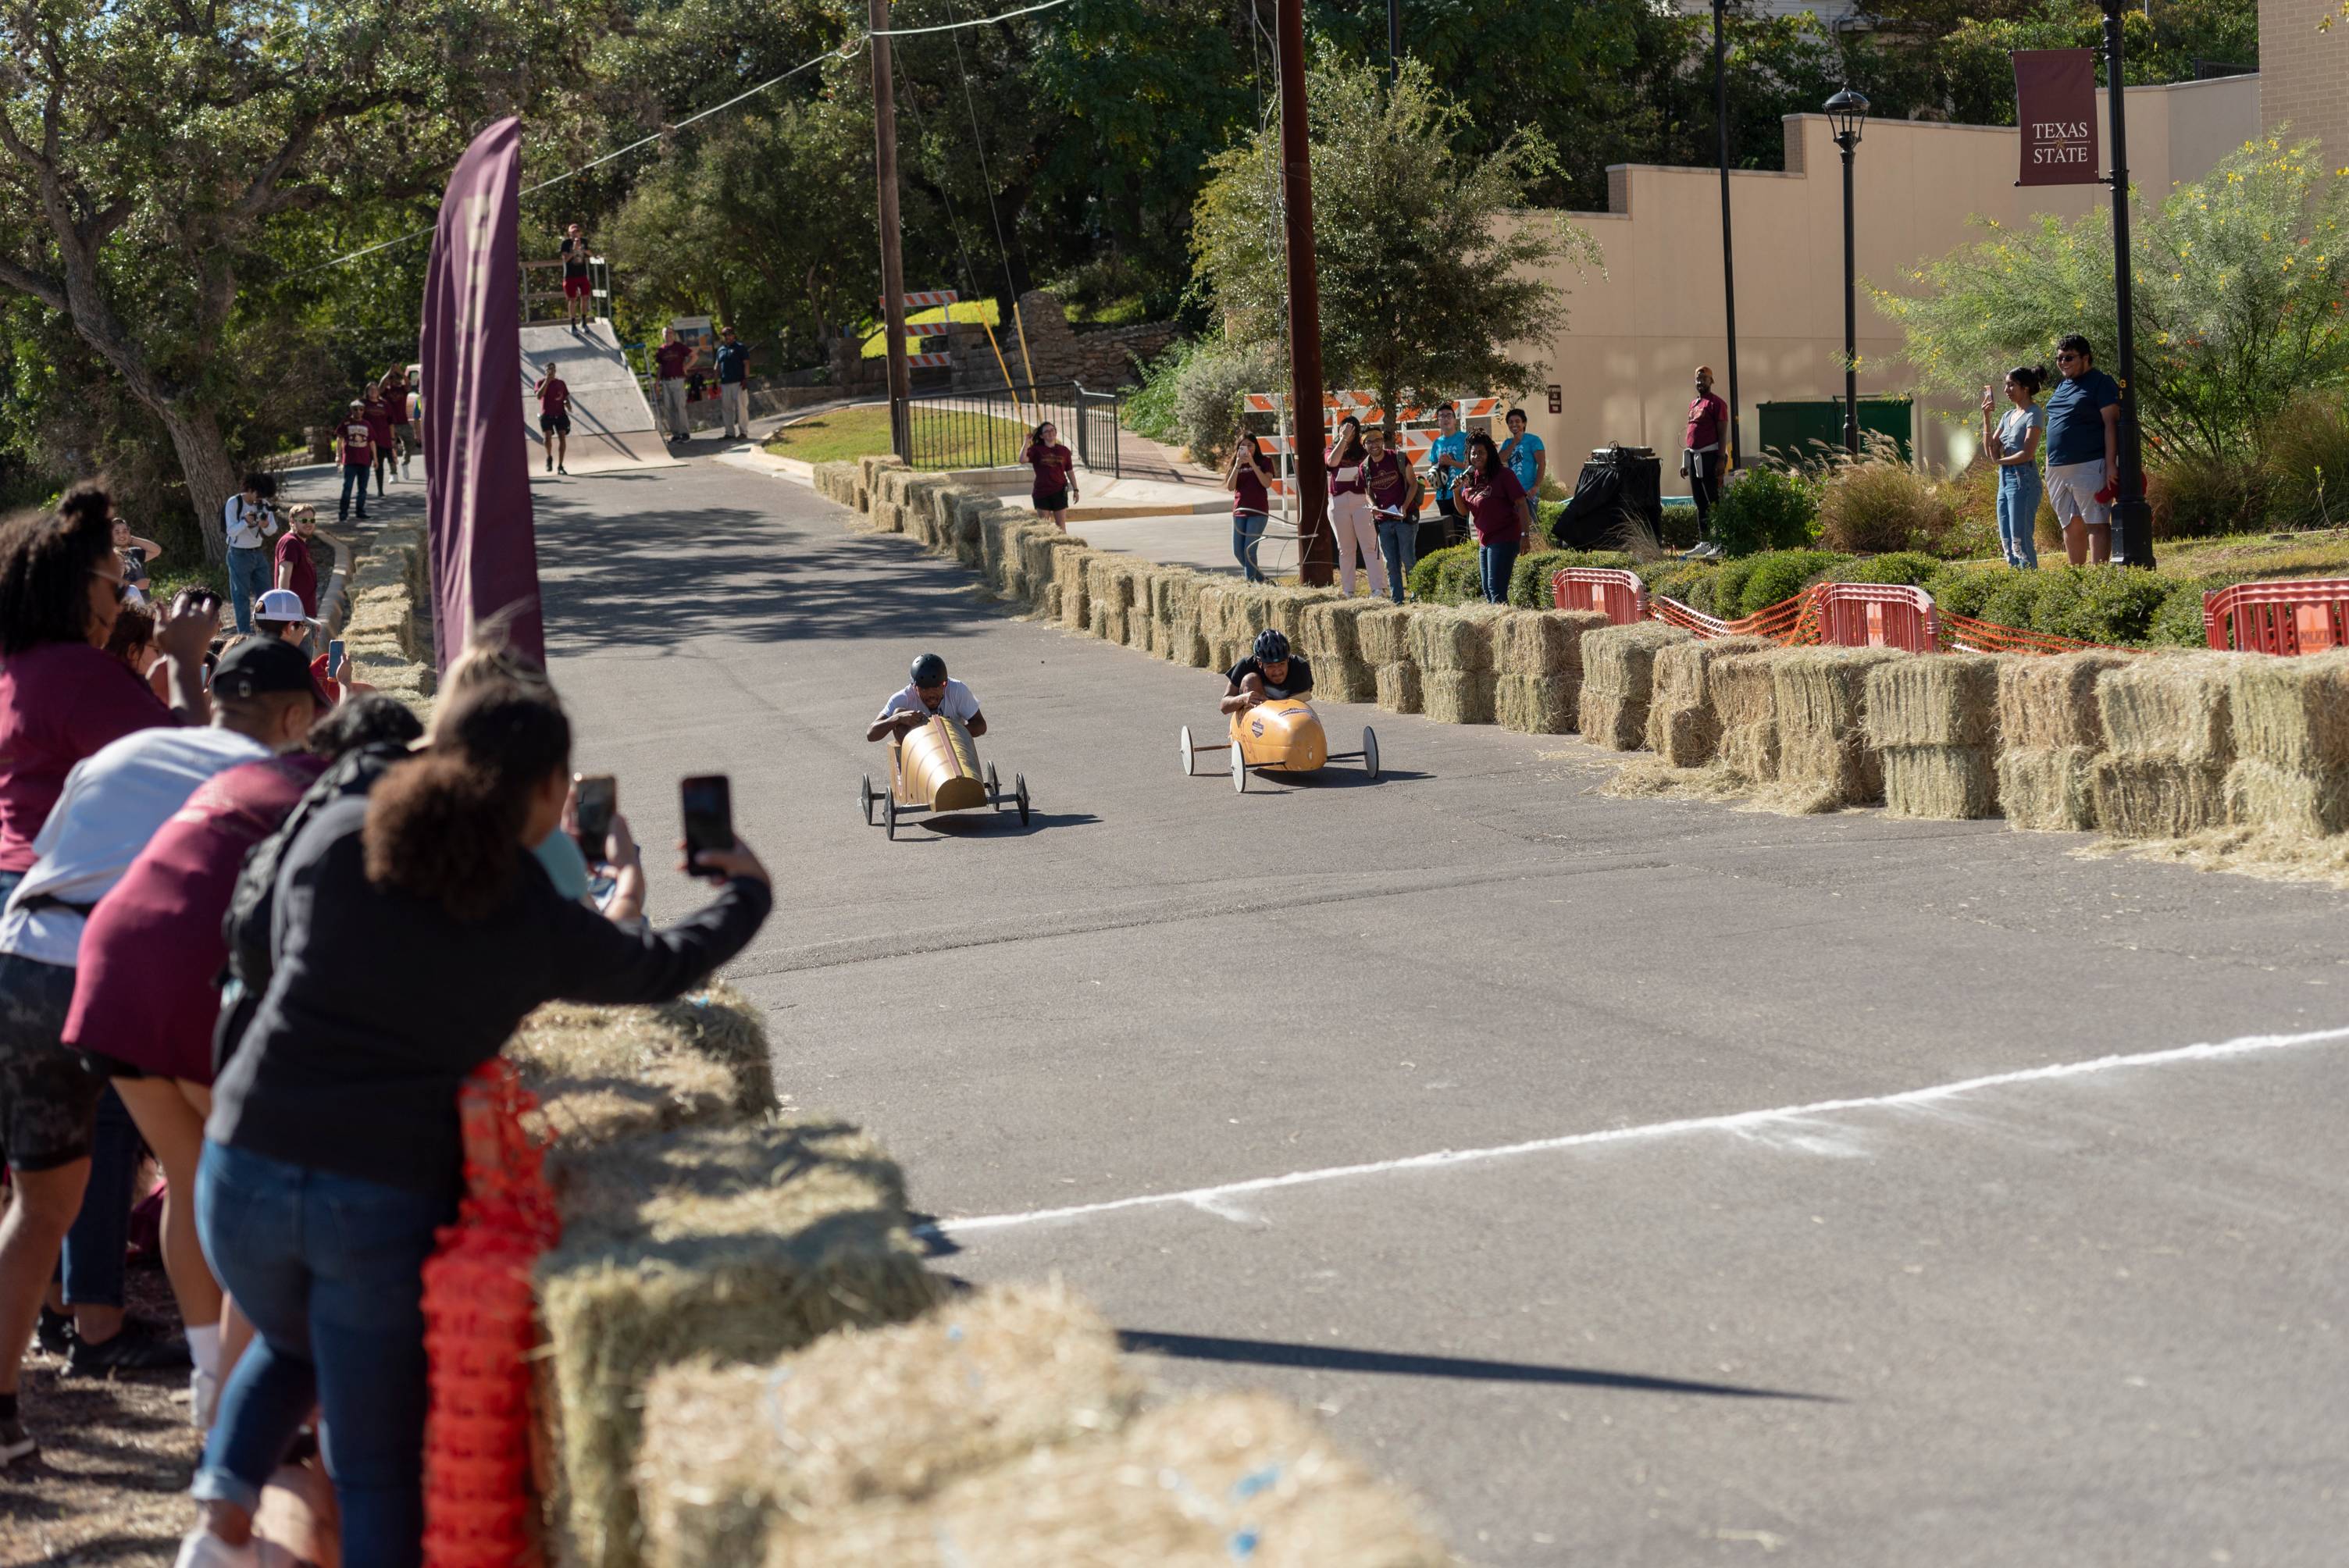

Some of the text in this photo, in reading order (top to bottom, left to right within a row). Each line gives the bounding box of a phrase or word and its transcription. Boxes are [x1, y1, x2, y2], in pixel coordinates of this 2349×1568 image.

[2032, 122, 2087, 138] TEXAS
[2034, 147, 2087, 163] STATE
[2299, 630, 2329, 645] POLICE
